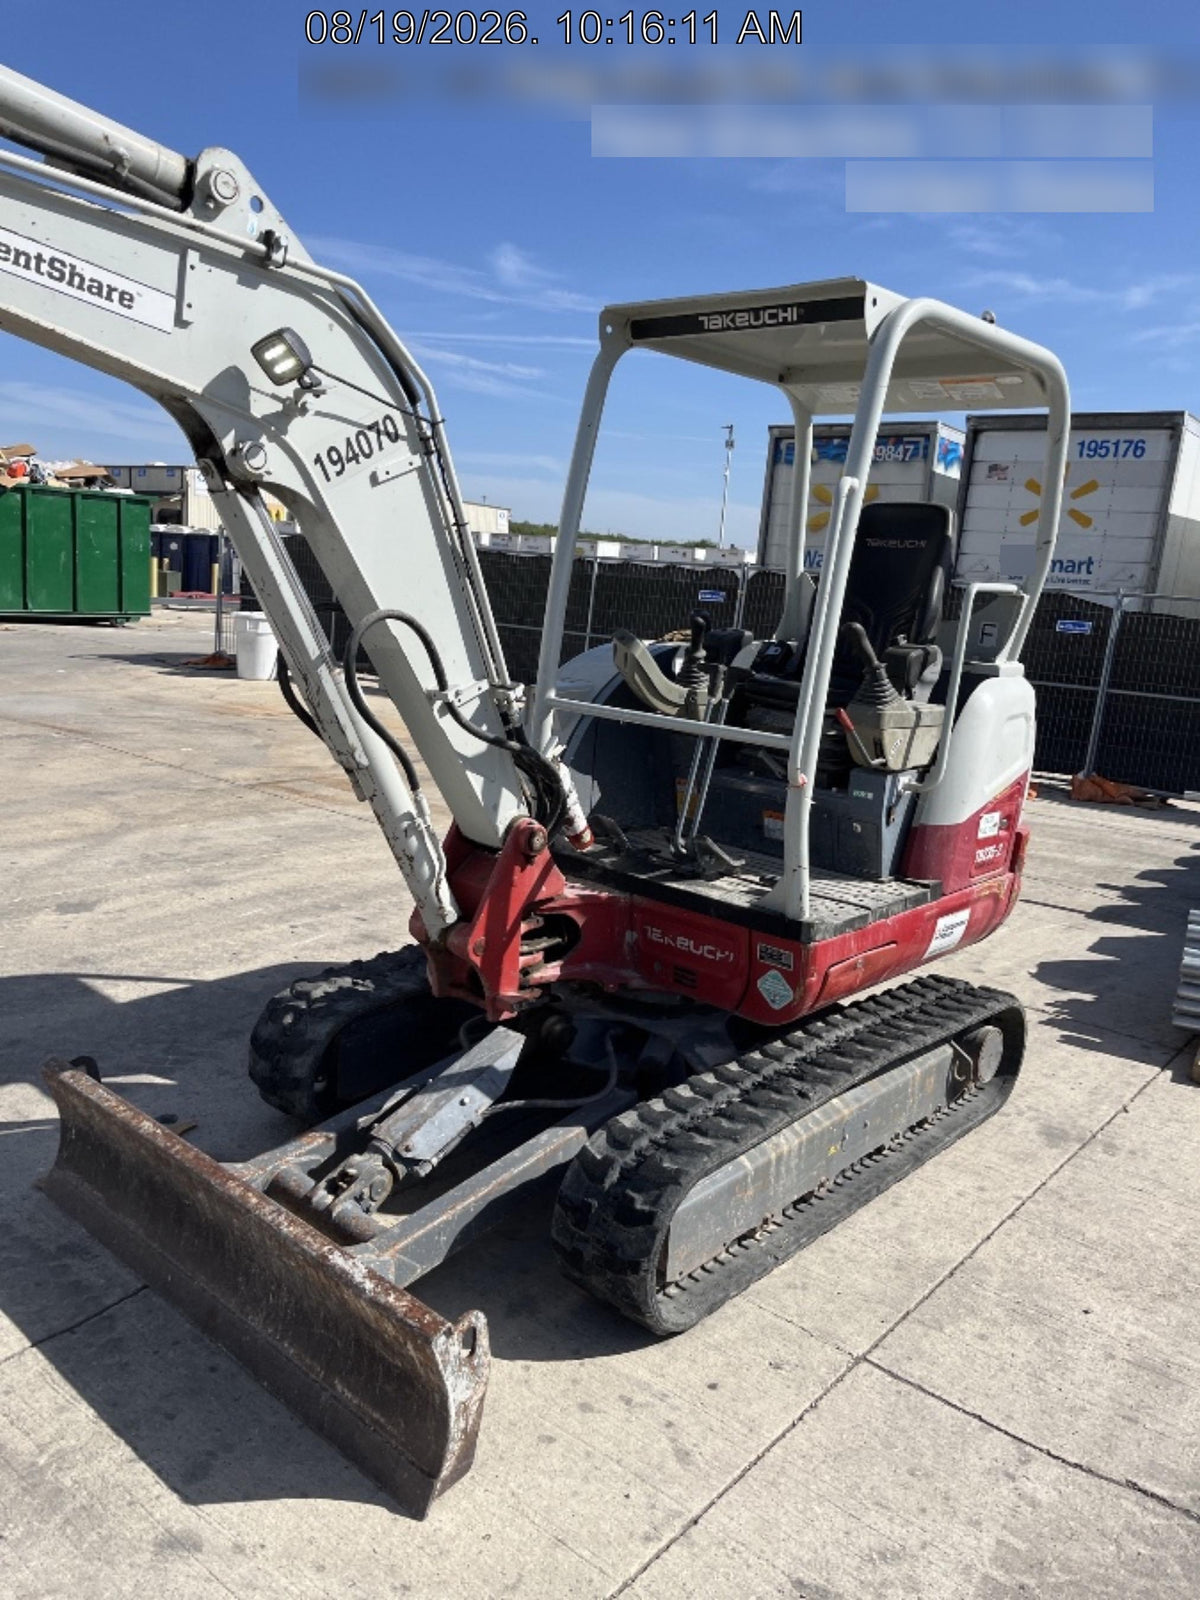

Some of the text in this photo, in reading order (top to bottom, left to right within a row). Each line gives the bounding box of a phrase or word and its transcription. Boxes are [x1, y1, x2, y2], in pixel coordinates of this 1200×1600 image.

[698, 306, 798, 330] TAKEUCHI
[314, 414, 399, 482] 194070
[873, 444, 915, 461] 9847
[1077, 439, 1146, 459] 195176
[1050, 556, 1094, 575] mart
